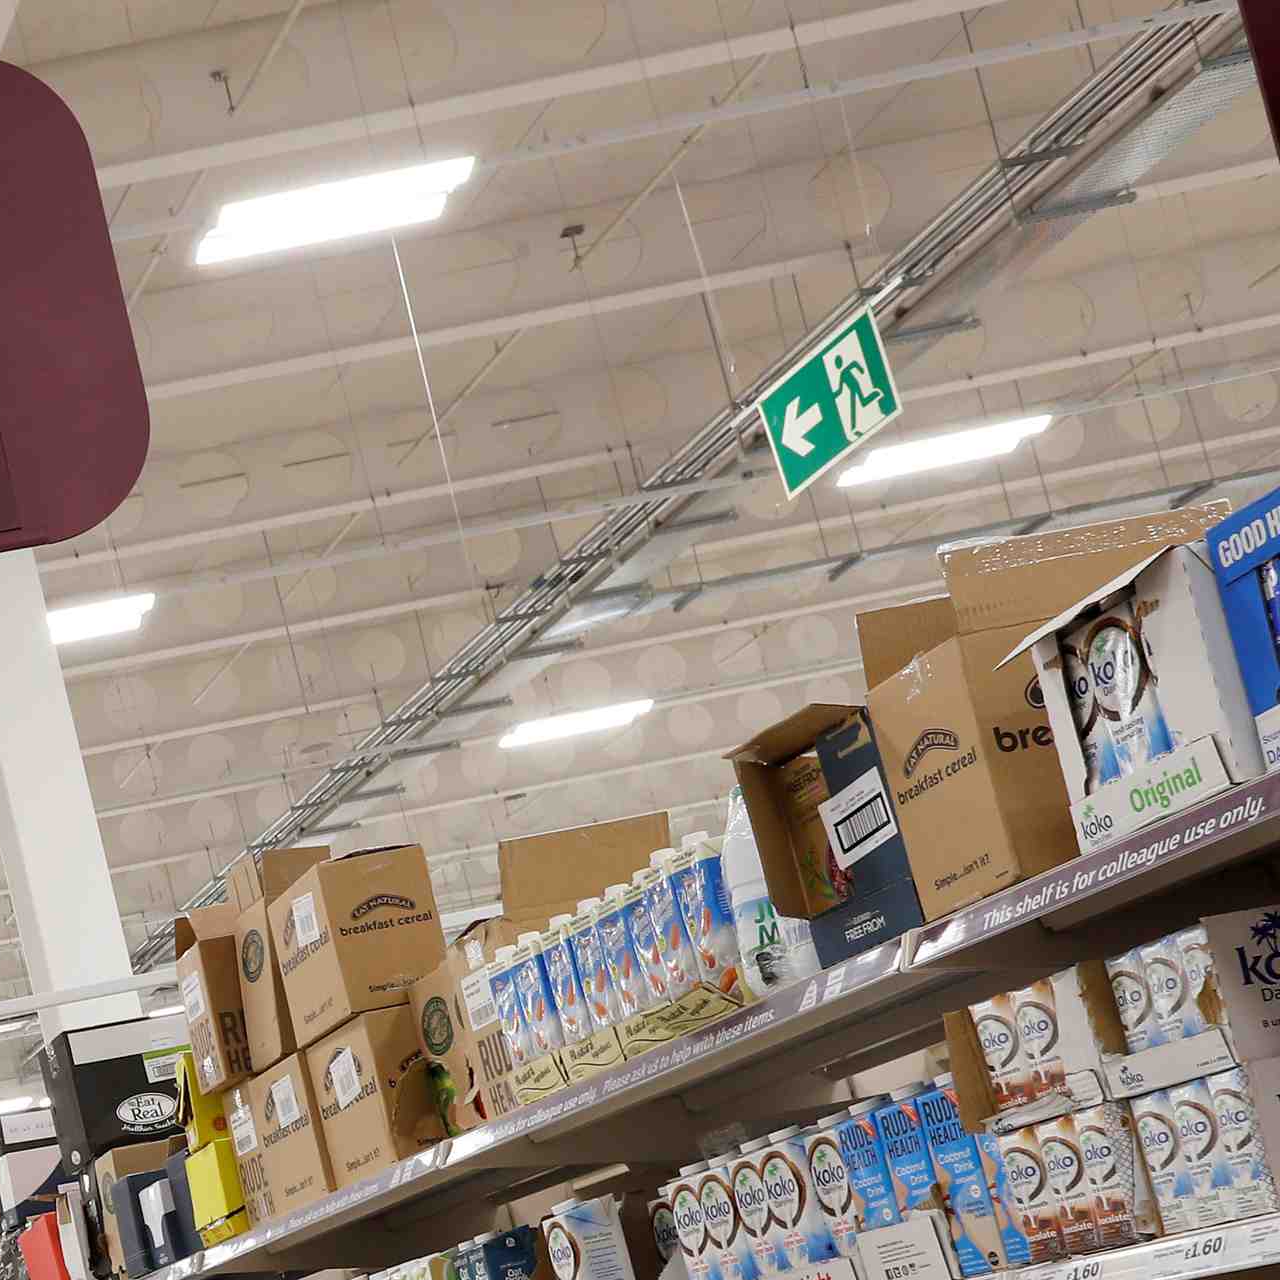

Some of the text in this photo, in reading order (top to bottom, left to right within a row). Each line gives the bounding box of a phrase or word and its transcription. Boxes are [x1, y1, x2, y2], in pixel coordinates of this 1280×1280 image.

[1216, 512, 1265, 570] GOOD
[897, 747, 978, 805] breakfast cereal
[1129, 763, 1203, 814] Original
[1080, 812, 1115, 841] koko
[982, 795, 1267, 931] This shelf is for colleague use only.
[339, 910, 433, 937] breakfast cereal
[603, 1072, 632, 1095] Please
[659, 1050, 672, 1069] to
[669, 1042, 694, 1071] help
[692, 1030, 717, 1057] with
[715, 1018, 744, 1047] these
[742, 1006, 777, 1033] items.
[131, 1102, 164, 1121] Real
[136, 1097, 155, 1109] Eat
[881, 1111, 916, 1139] RUDE
[840, 1126, 872, 1152] RUDE
[887, 1136, 921, 1159] HEALTH
[845, 1146, 878, 1170] HEALTH
[895, 1160, 925, 1176] Coconut
[939, 1148, 971, 1165] Coconut
[814, 1160, 845, 1187] koko
[736, 1186, 765, 1210] koko
[765, 1174, 796, 1200] koko
[675, 1205, 703, 1230] koko
[703, 1198, 731, 1223] koko
[550, 1239, 572, 1267] koko
[1184, 1236, 1222, 1260] £1.60
